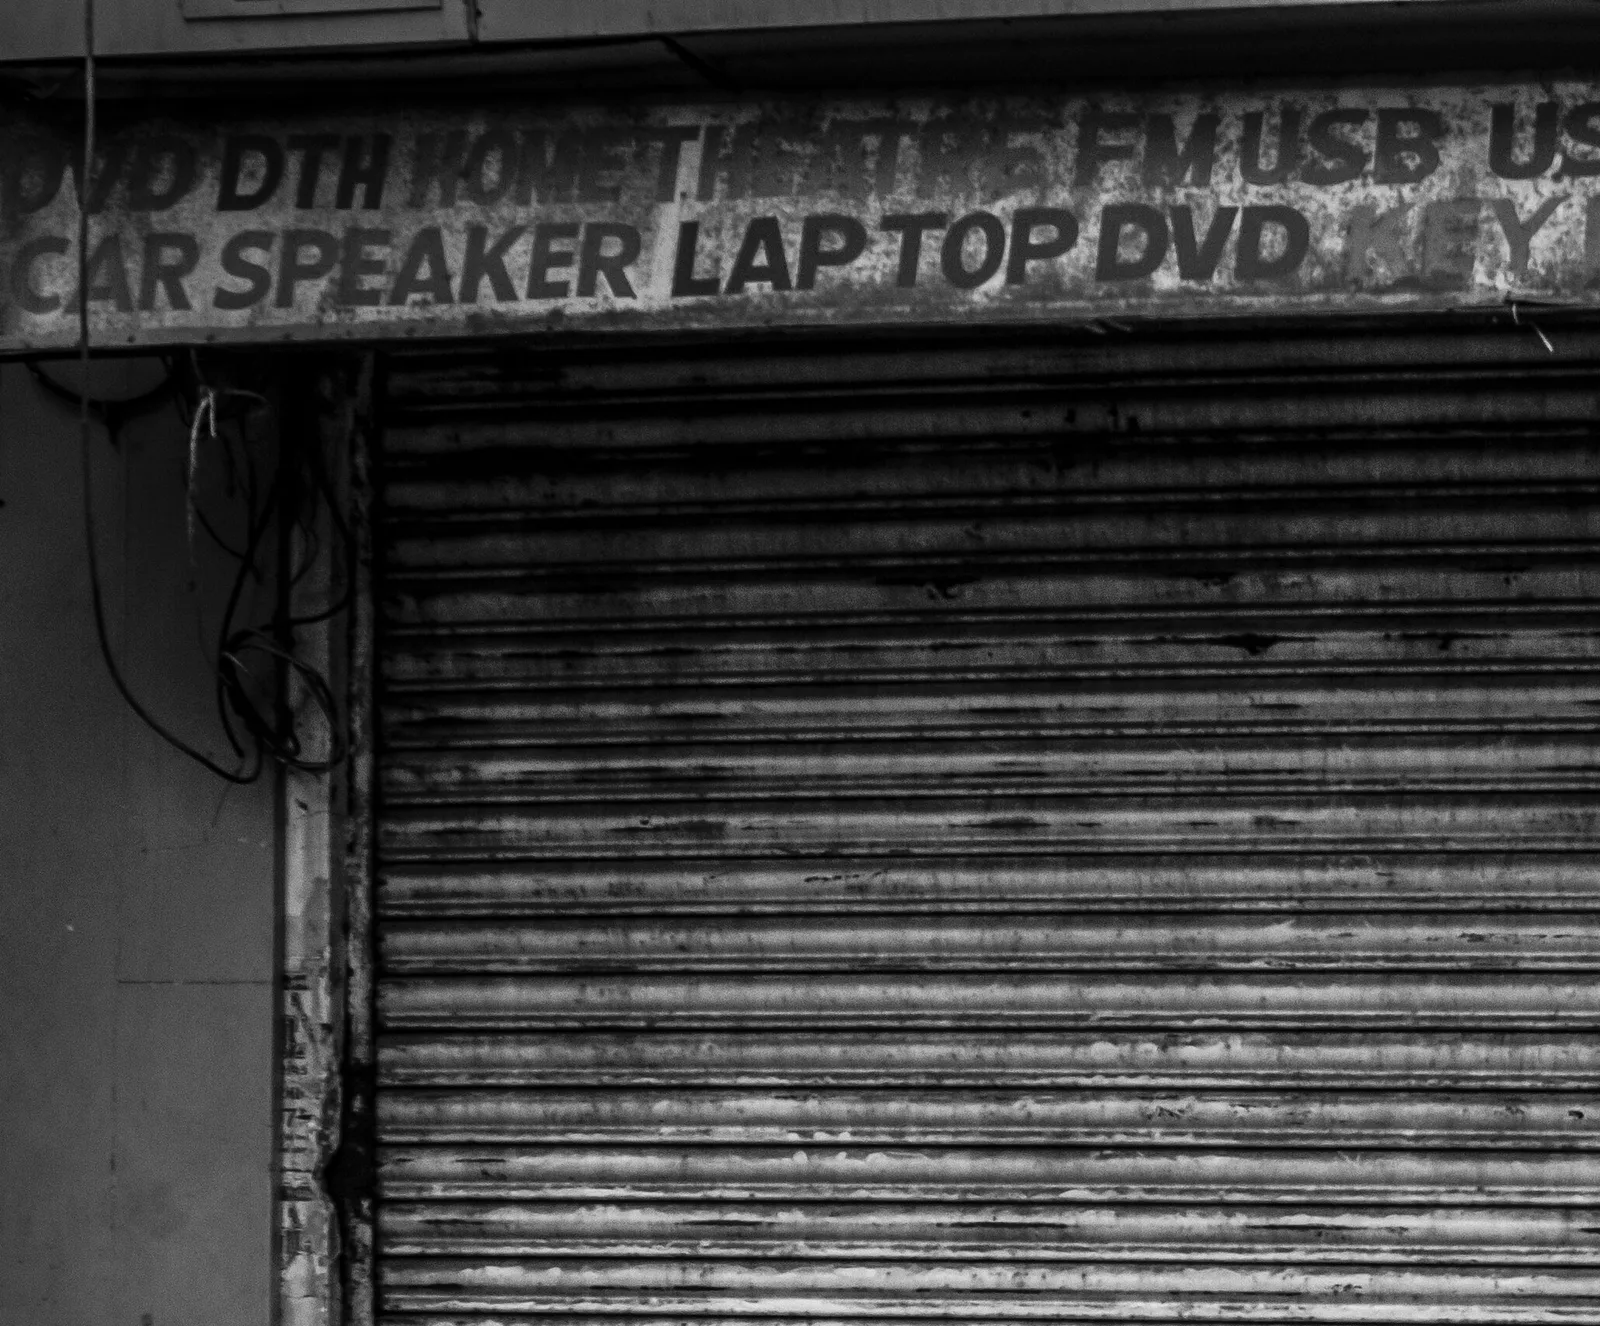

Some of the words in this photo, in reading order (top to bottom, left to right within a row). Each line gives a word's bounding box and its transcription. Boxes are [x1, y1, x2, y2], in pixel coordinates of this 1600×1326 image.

[216, 133, 393, 211] DTH
[1239, 105, 1447, 185] USB
[10, 231, 200, 315] CAR
[212, 221, 642, 311] SPEAKER
[1095, 201, 1312, 285] DVD
